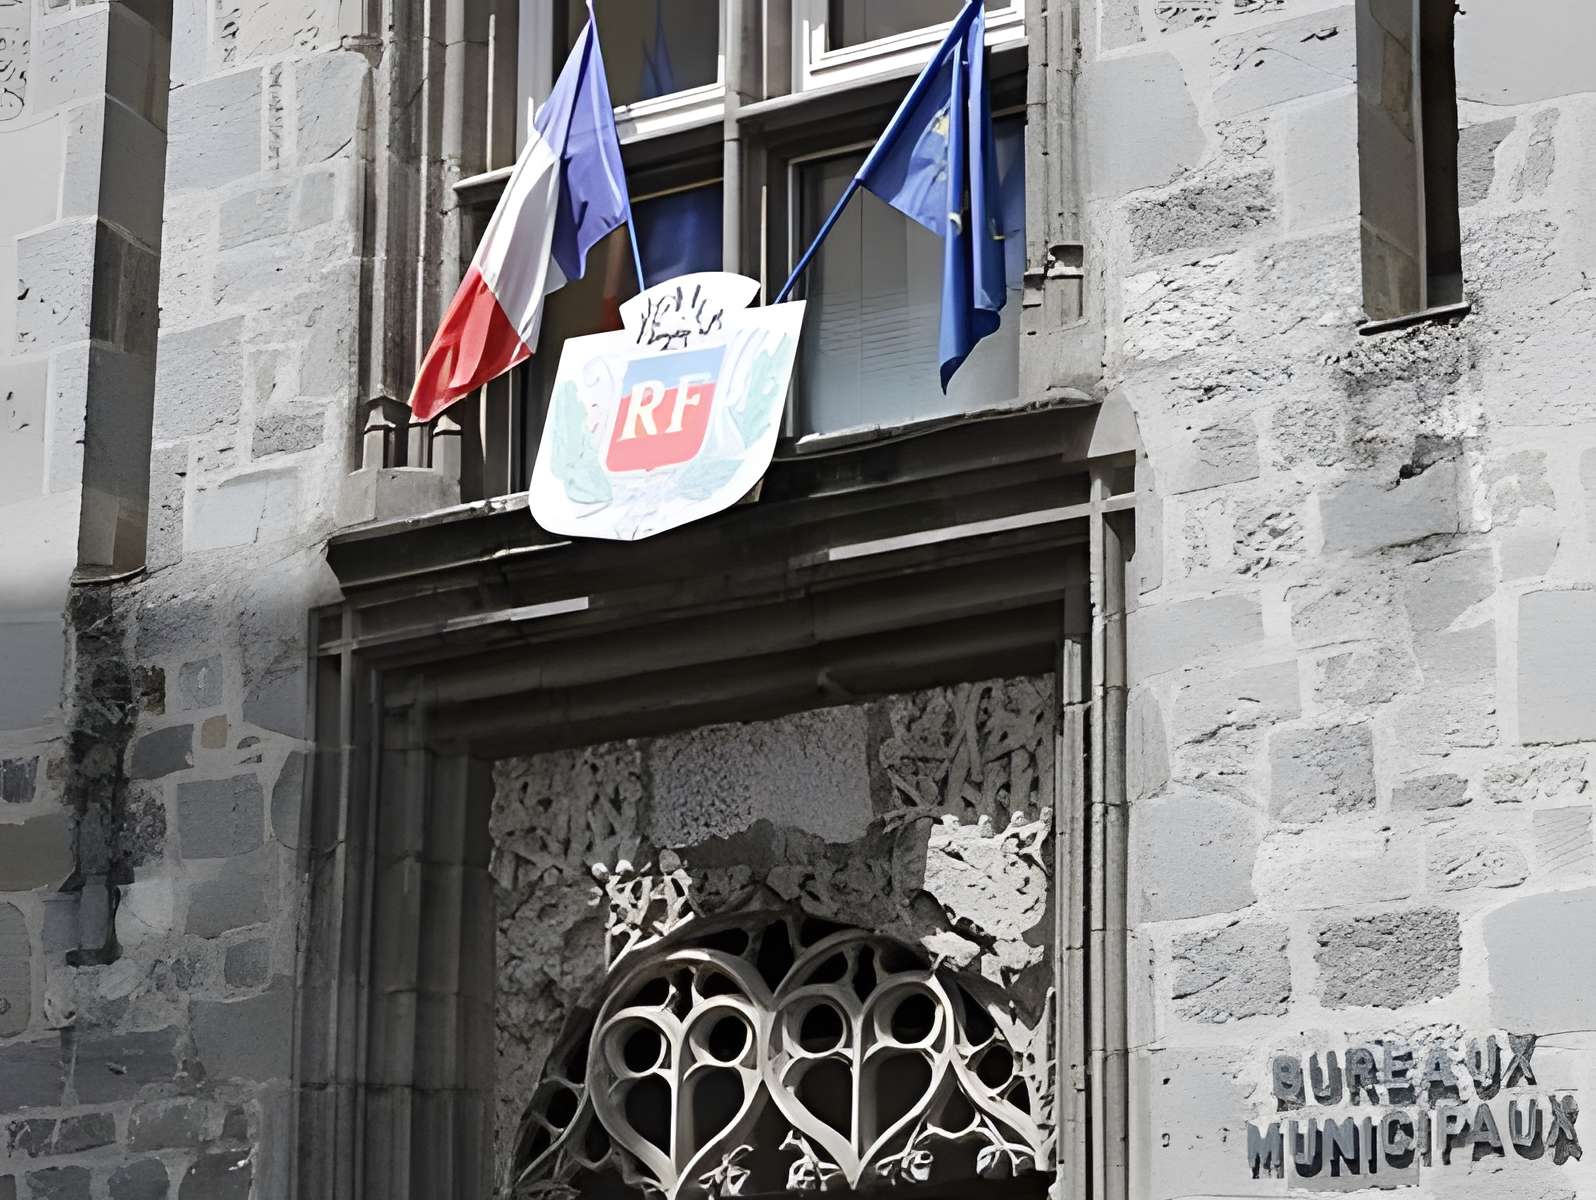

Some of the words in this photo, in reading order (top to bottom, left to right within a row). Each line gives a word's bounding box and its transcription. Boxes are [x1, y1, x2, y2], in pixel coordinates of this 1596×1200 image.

[617, 372, 713, 442] RF
[1271, 1034, 1538, 1112] BUREAUX
[1247, 1094, 1583, 1179] MUNICIPAUX
